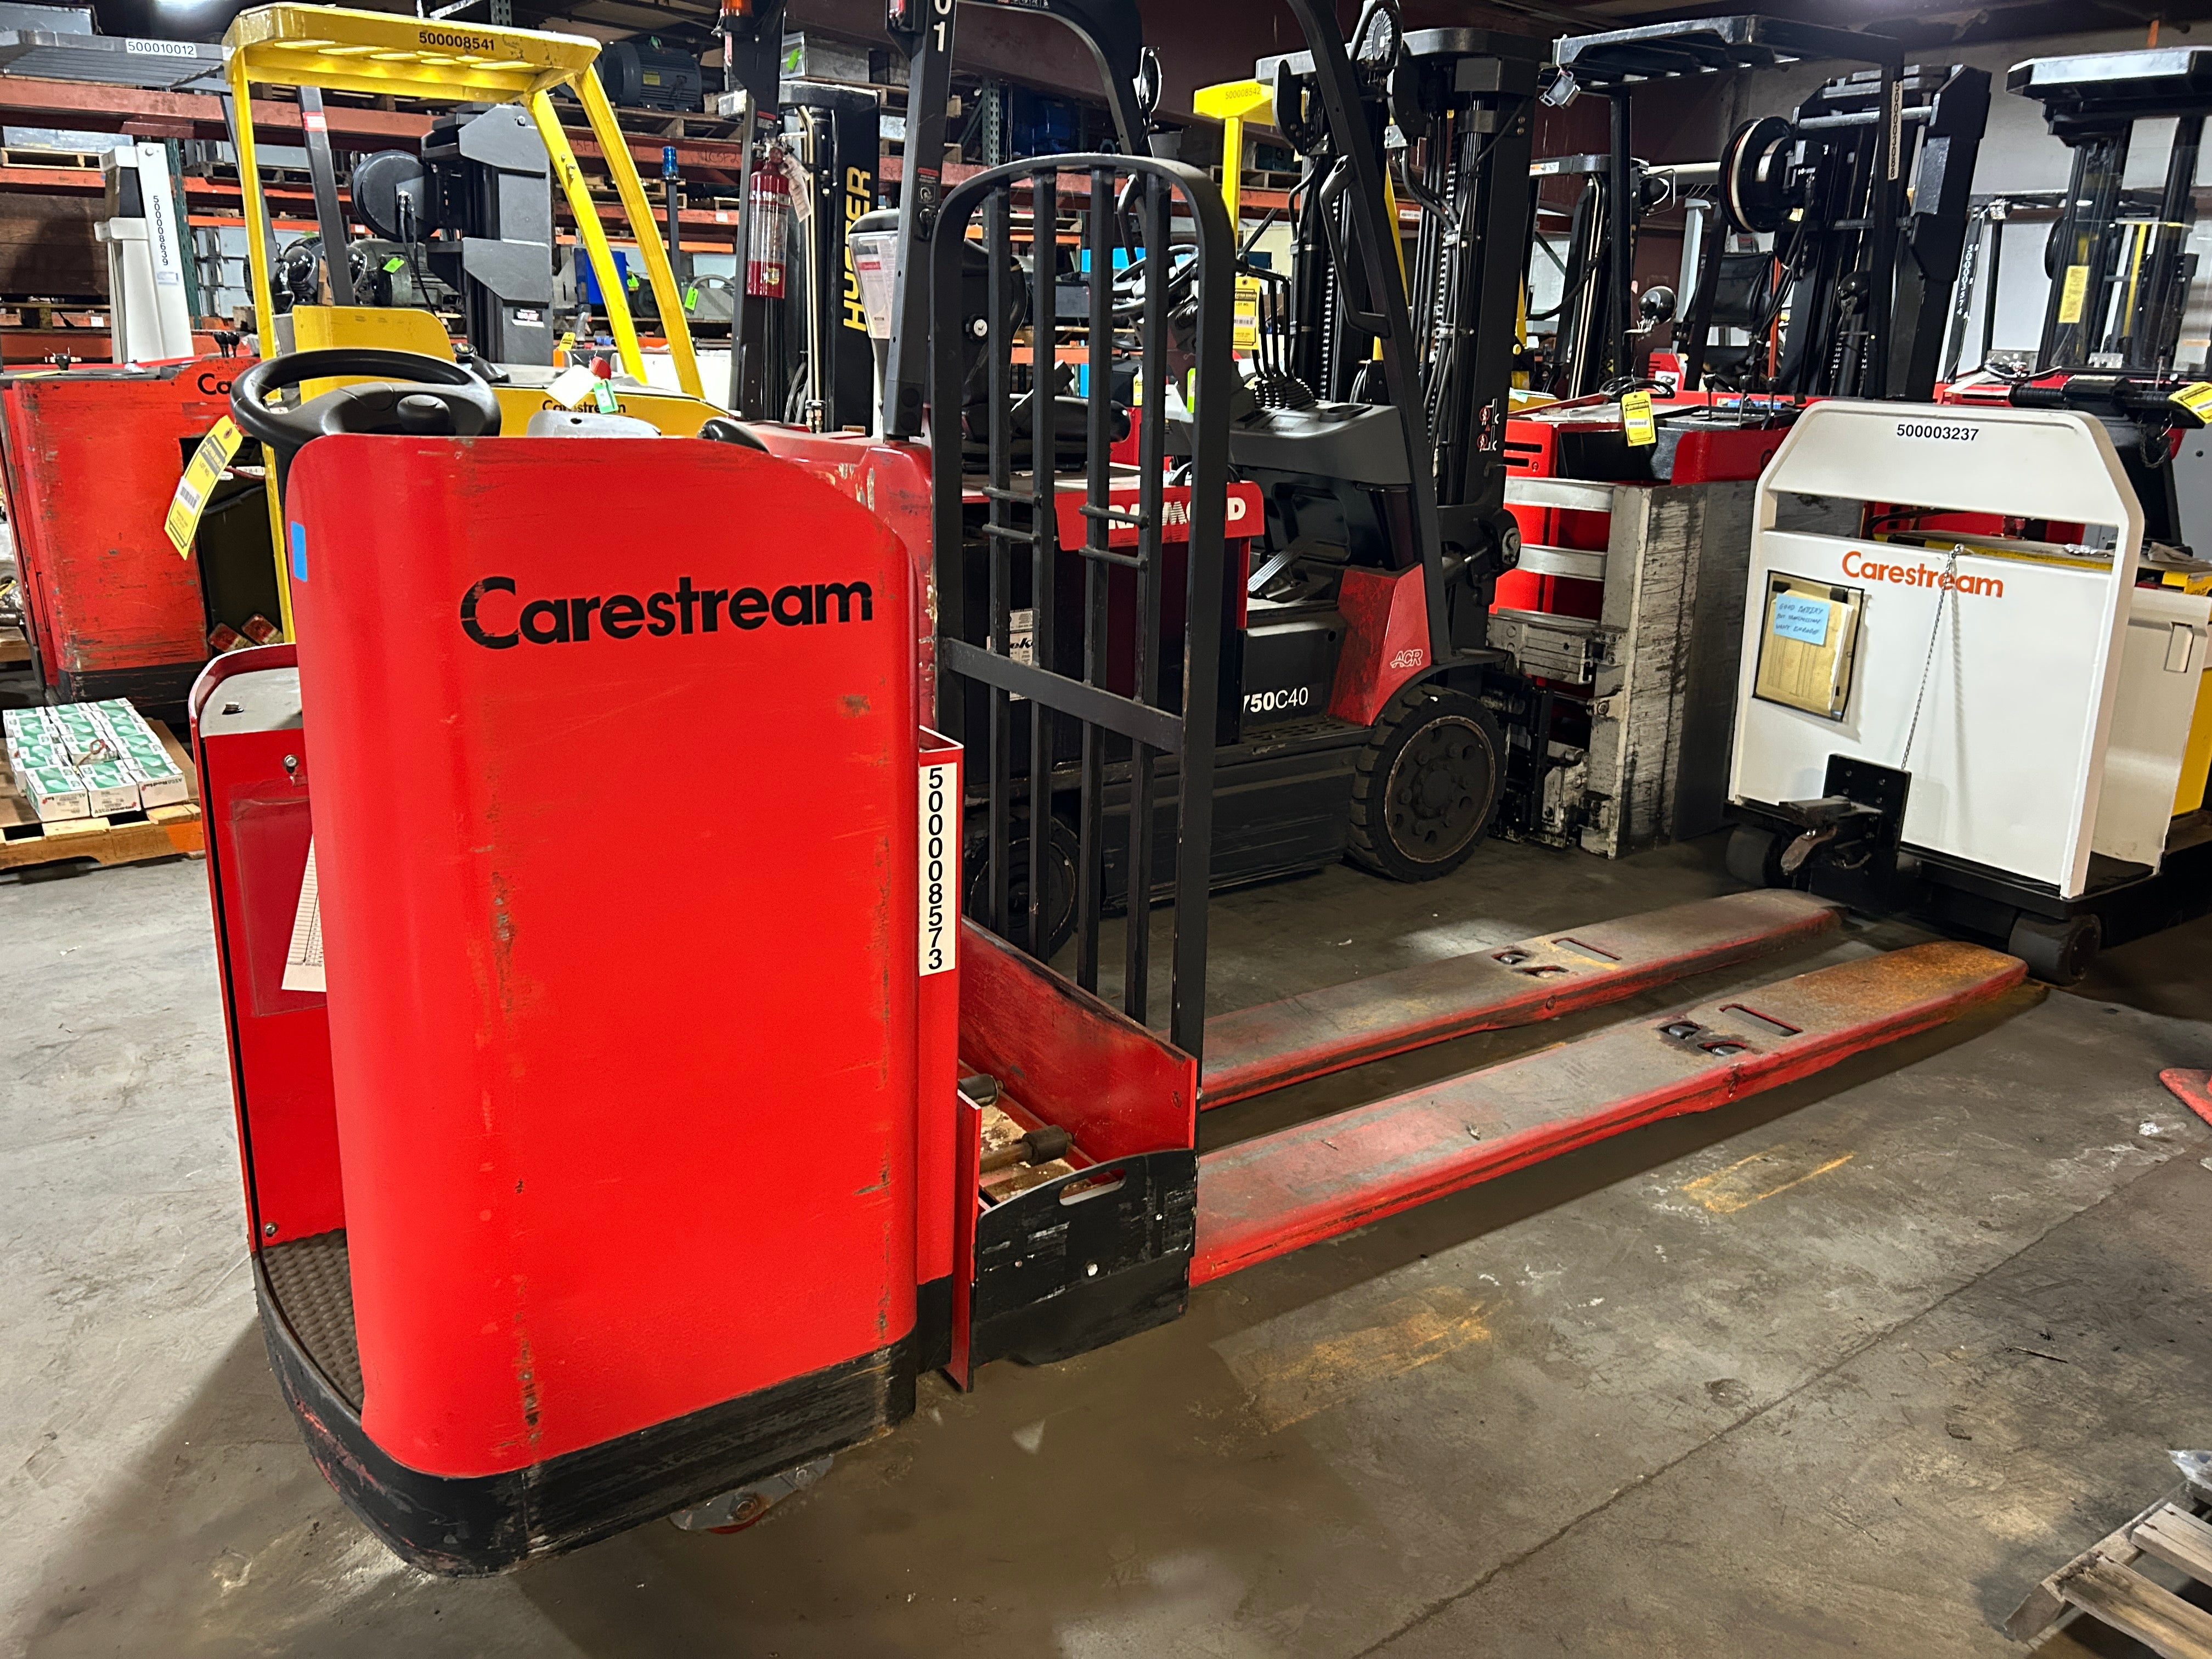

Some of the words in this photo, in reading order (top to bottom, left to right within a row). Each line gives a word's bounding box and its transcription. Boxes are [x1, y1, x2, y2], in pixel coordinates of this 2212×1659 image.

[128, 41, 194, 55] 500010012
[419, 31, 494, 50] 500008541
[1225, 87, 1261, 100] 500008542
[153, 195, 168, 266] 500008639
[843, 166, 872, 332] HYER
[1897, 424, 1979, 441] 500003237
[1842, 551, 2004, 598] Carestream
[460, 575, 873, 650] Carestream
[1390, 649, 1423, 669] ACR
[928, 767, 944, 970] 500008573
